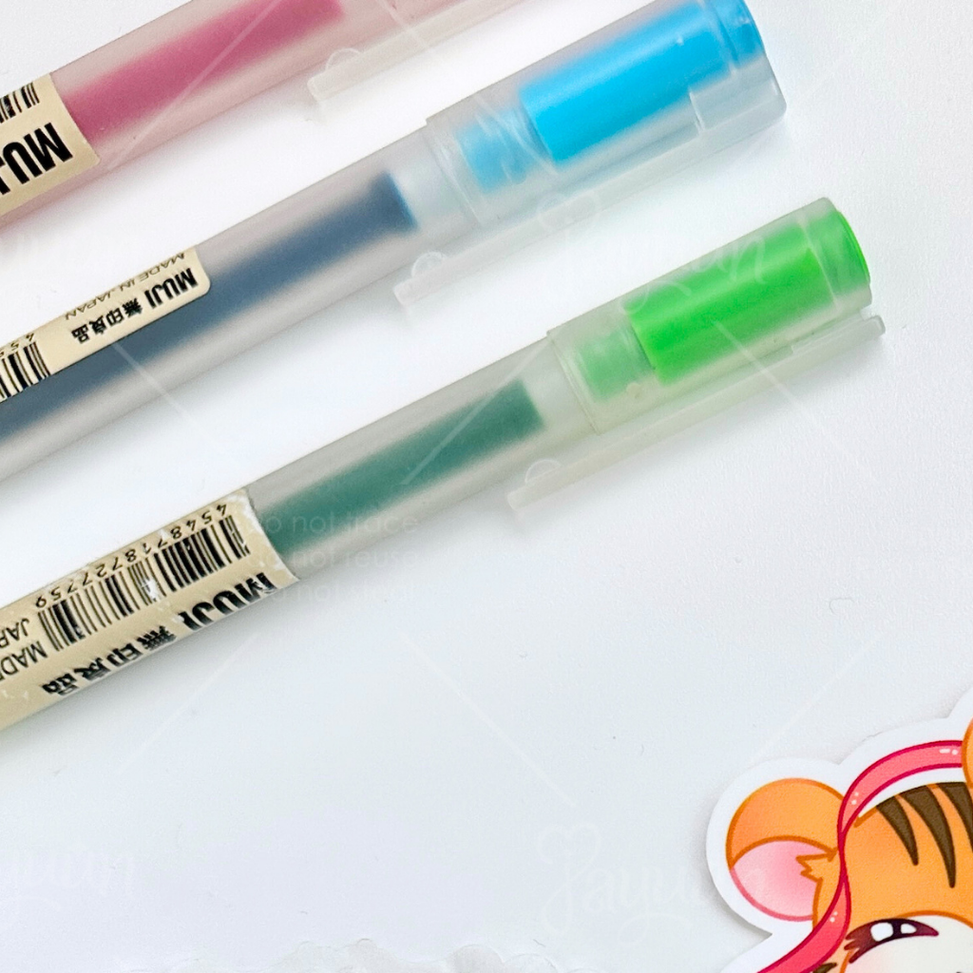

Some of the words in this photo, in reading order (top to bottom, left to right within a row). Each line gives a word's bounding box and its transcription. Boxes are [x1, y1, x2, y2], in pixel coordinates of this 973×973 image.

[139, 251, 185, 282] MADE
[65, 292, 111, 320] JAPAN
[144, 267, 198, 309] MUJI
[71, 297, 143, 344] 無印良品
[178, 572, 277, 631] MUJI
